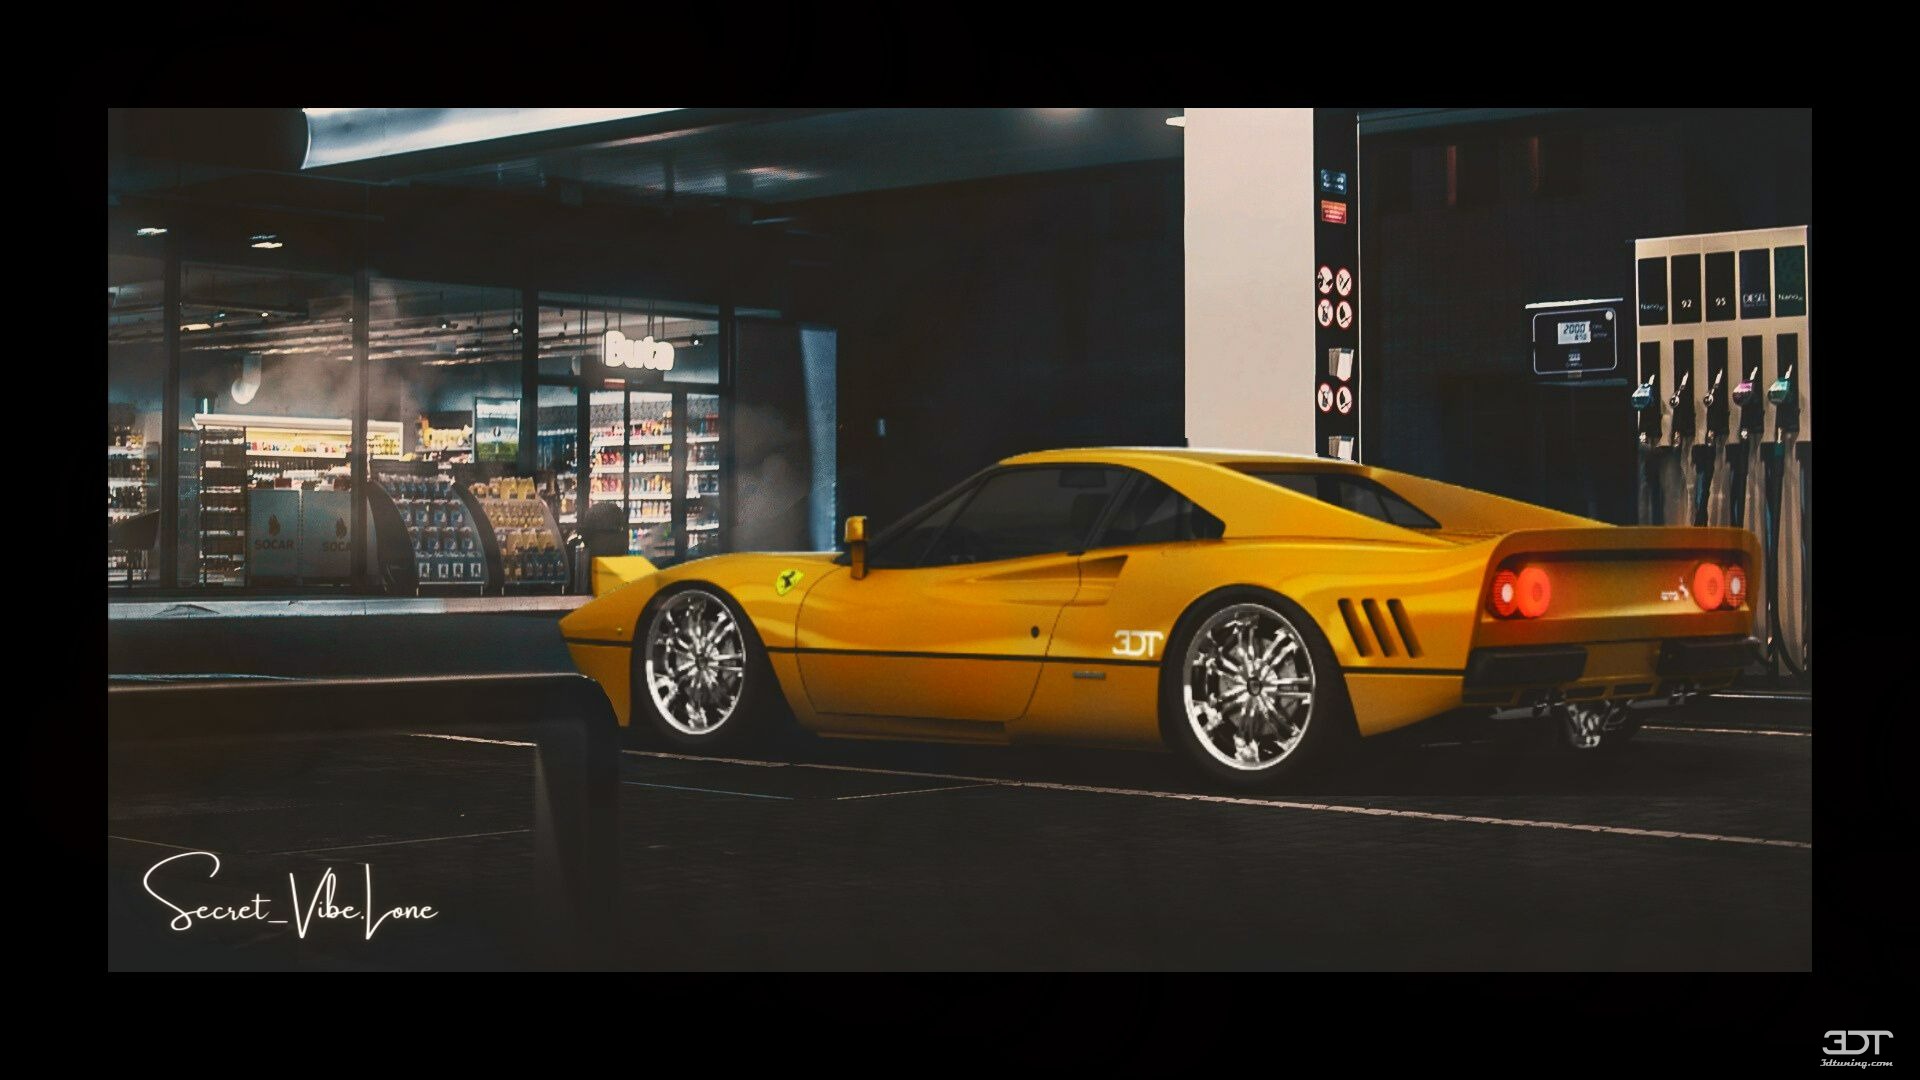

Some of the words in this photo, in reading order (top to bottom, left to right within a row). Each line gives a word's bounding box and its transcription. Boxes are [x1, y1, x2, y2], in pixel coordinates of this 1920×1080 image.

[1682, 299, 1692, 308] 92
[1716, 297, 1726, 306] 95
[602, 330, 675, 371] Buta
[255, 540, 295, 550] SOCAR
[1111, 629, 1164, 657] 3DT
